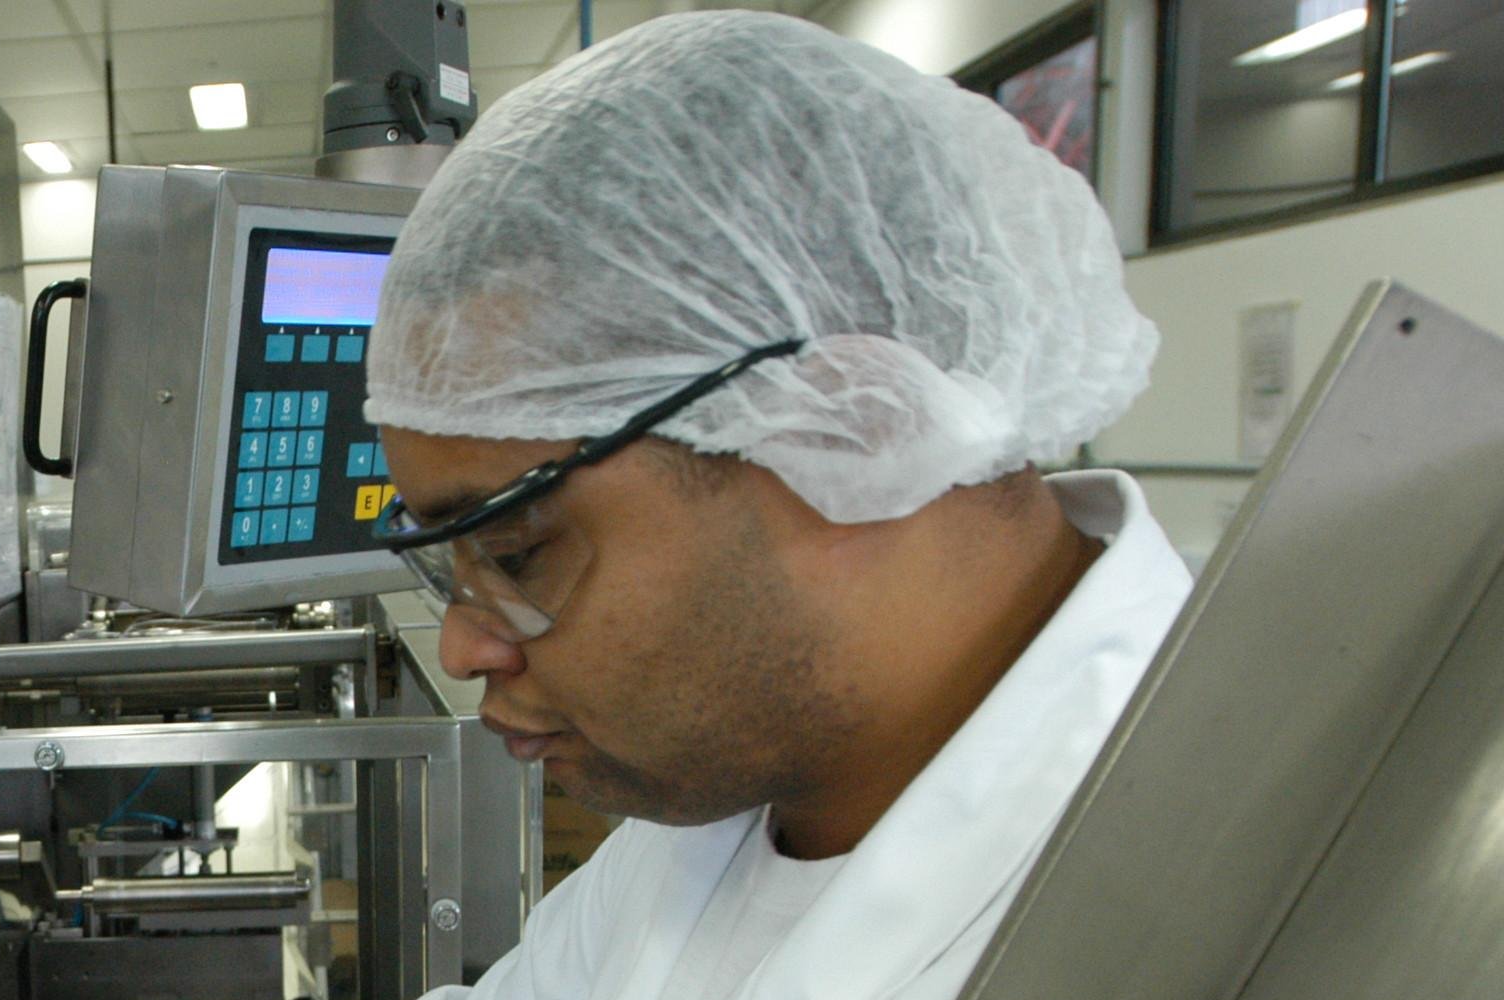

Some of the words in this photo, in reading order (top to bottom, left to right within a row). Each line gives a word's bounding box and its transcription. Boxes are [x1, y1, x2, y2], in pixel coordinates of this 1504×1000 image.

[254, 398, 263, 414] 7
[282, 397, 291, 413] 8
[311, 396, 320, 413] 9
[250, 438, 258, 454] 4
[279, 437, 287, 453] 5
[307, 436, 315, 452] 6
[247, 478, 253, 494] 1
[275, 476, 283, 492] 2
[303, 474, 311, 490] 3
[364, 495, 372, 509] E
[242, 516, 250, 533] 0
